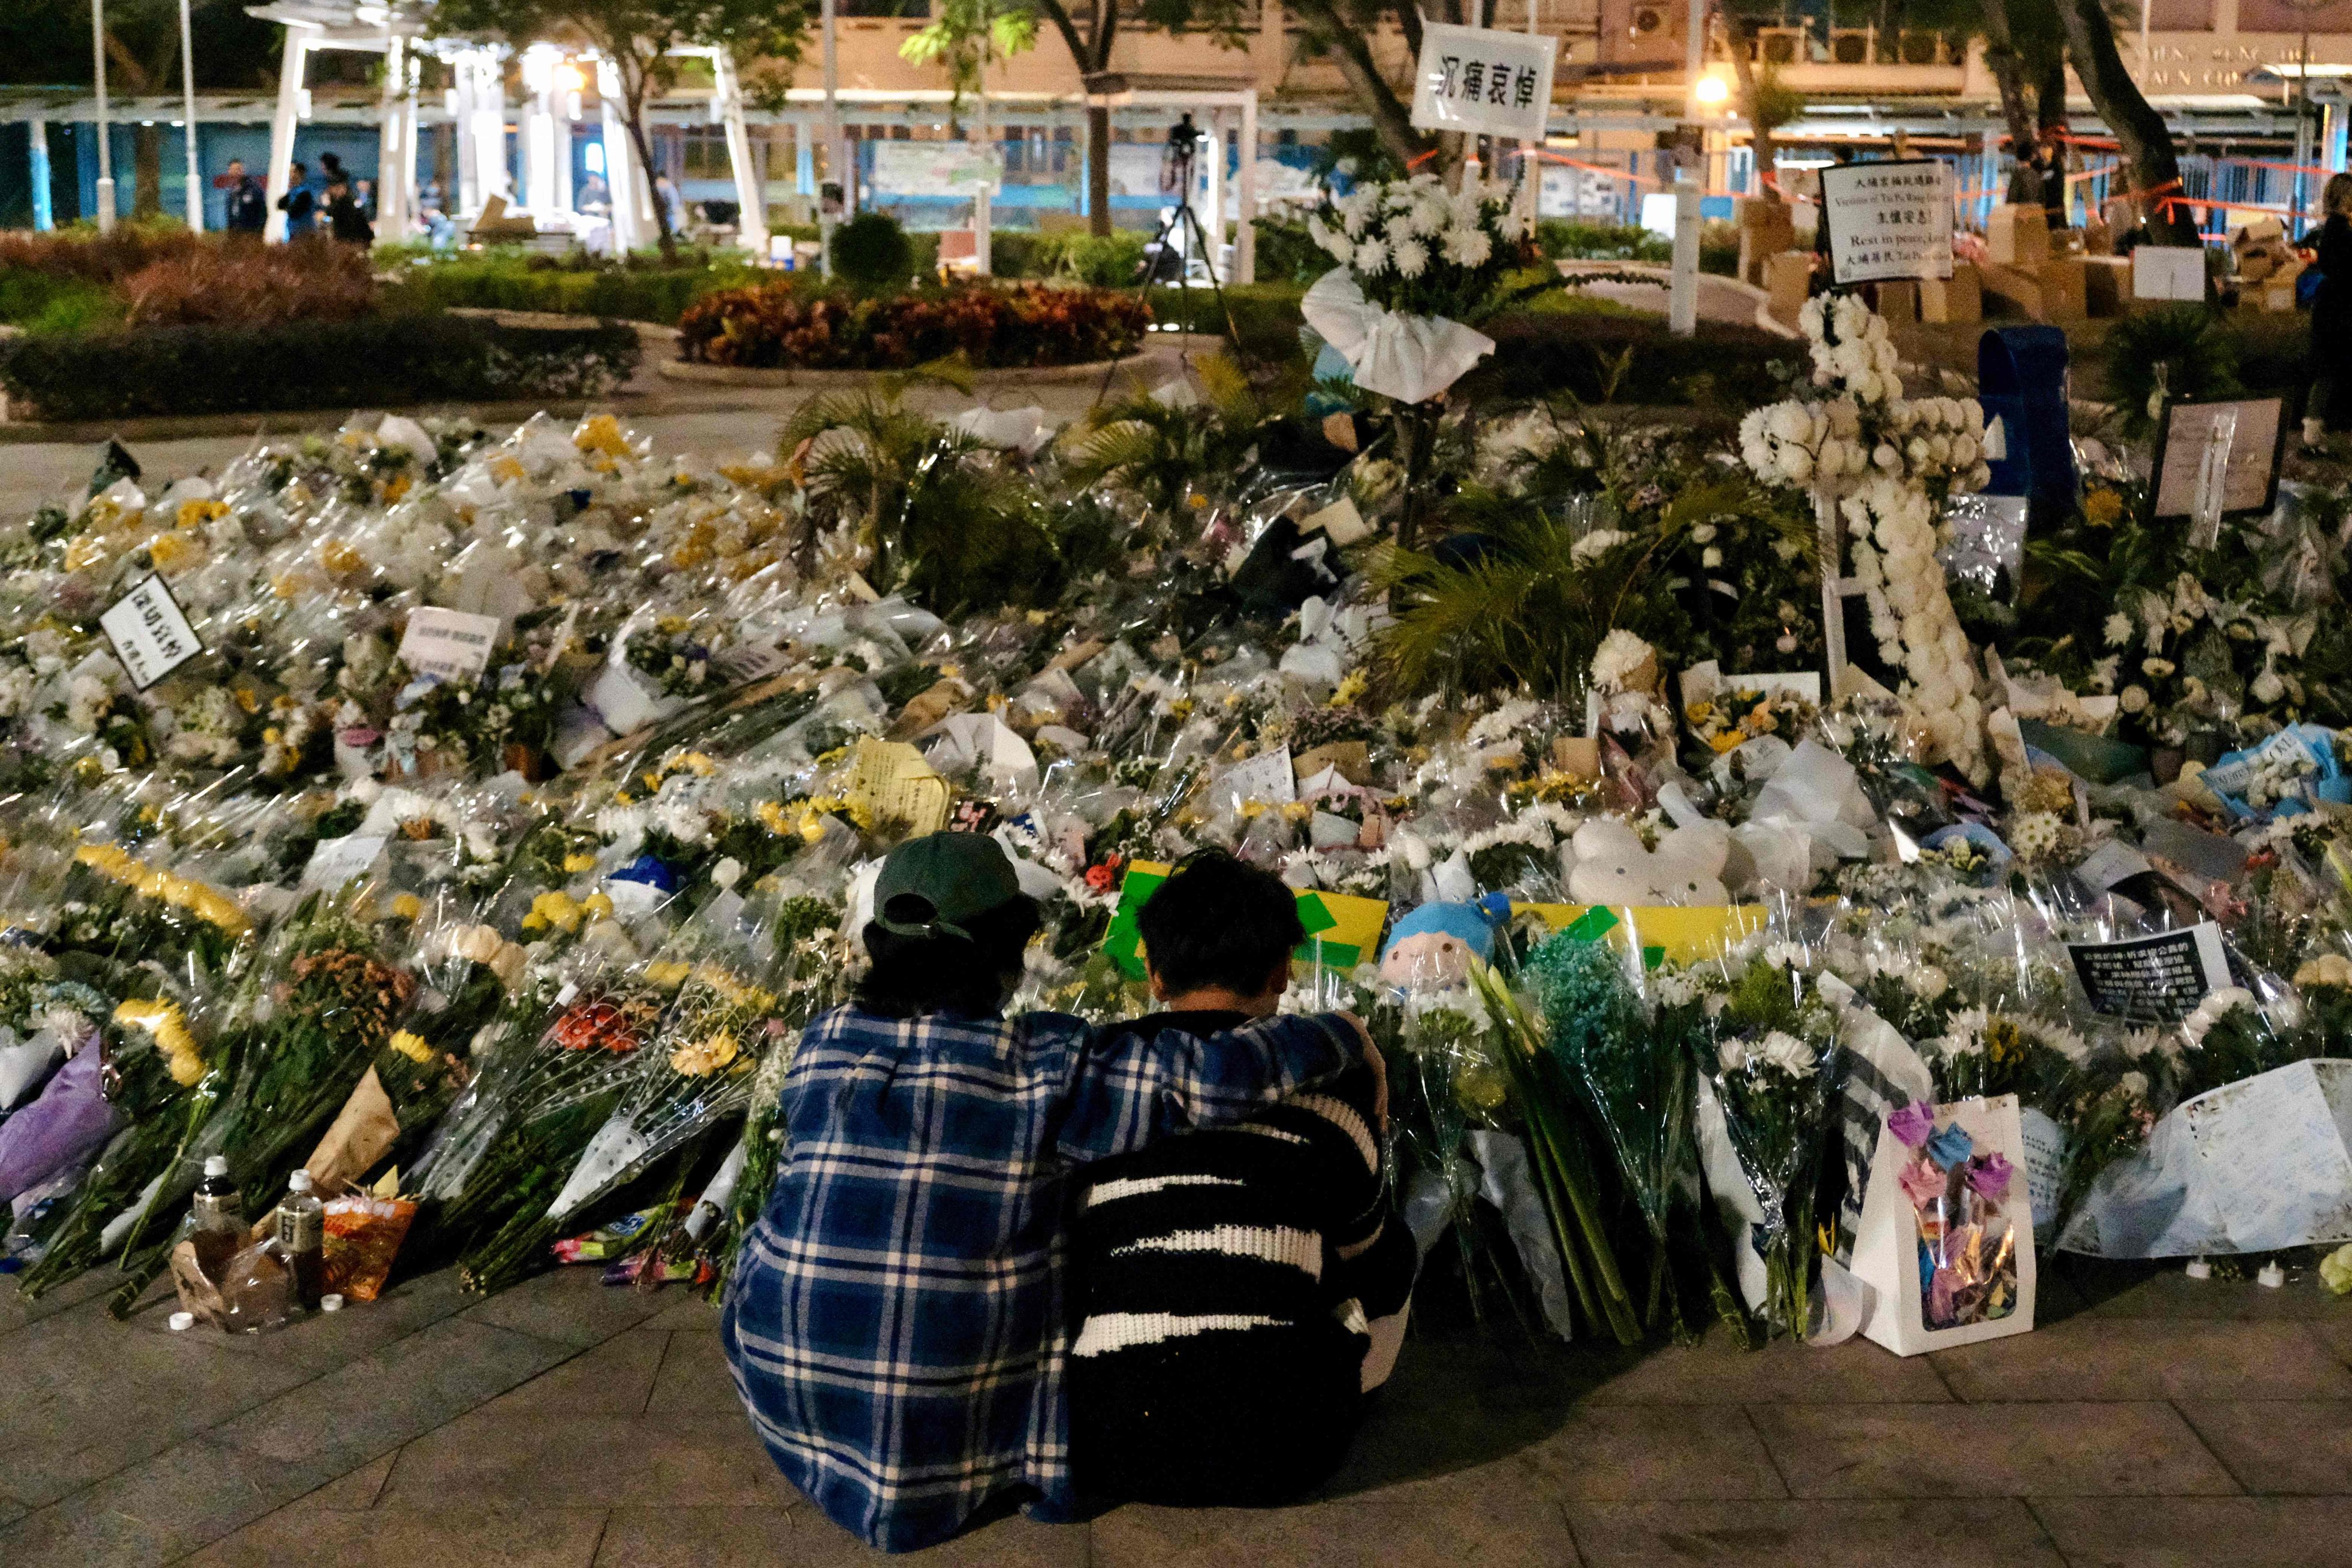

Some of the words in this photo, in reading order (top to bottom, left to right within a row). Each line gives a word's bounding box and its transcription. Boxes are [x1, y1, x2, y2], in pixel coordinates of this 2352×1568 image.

[1434, 55, 1538, 110] 沉痛哀悼
[1850, 235, 1878, 247] Rest
[1882, 234, 1893, 245] in
